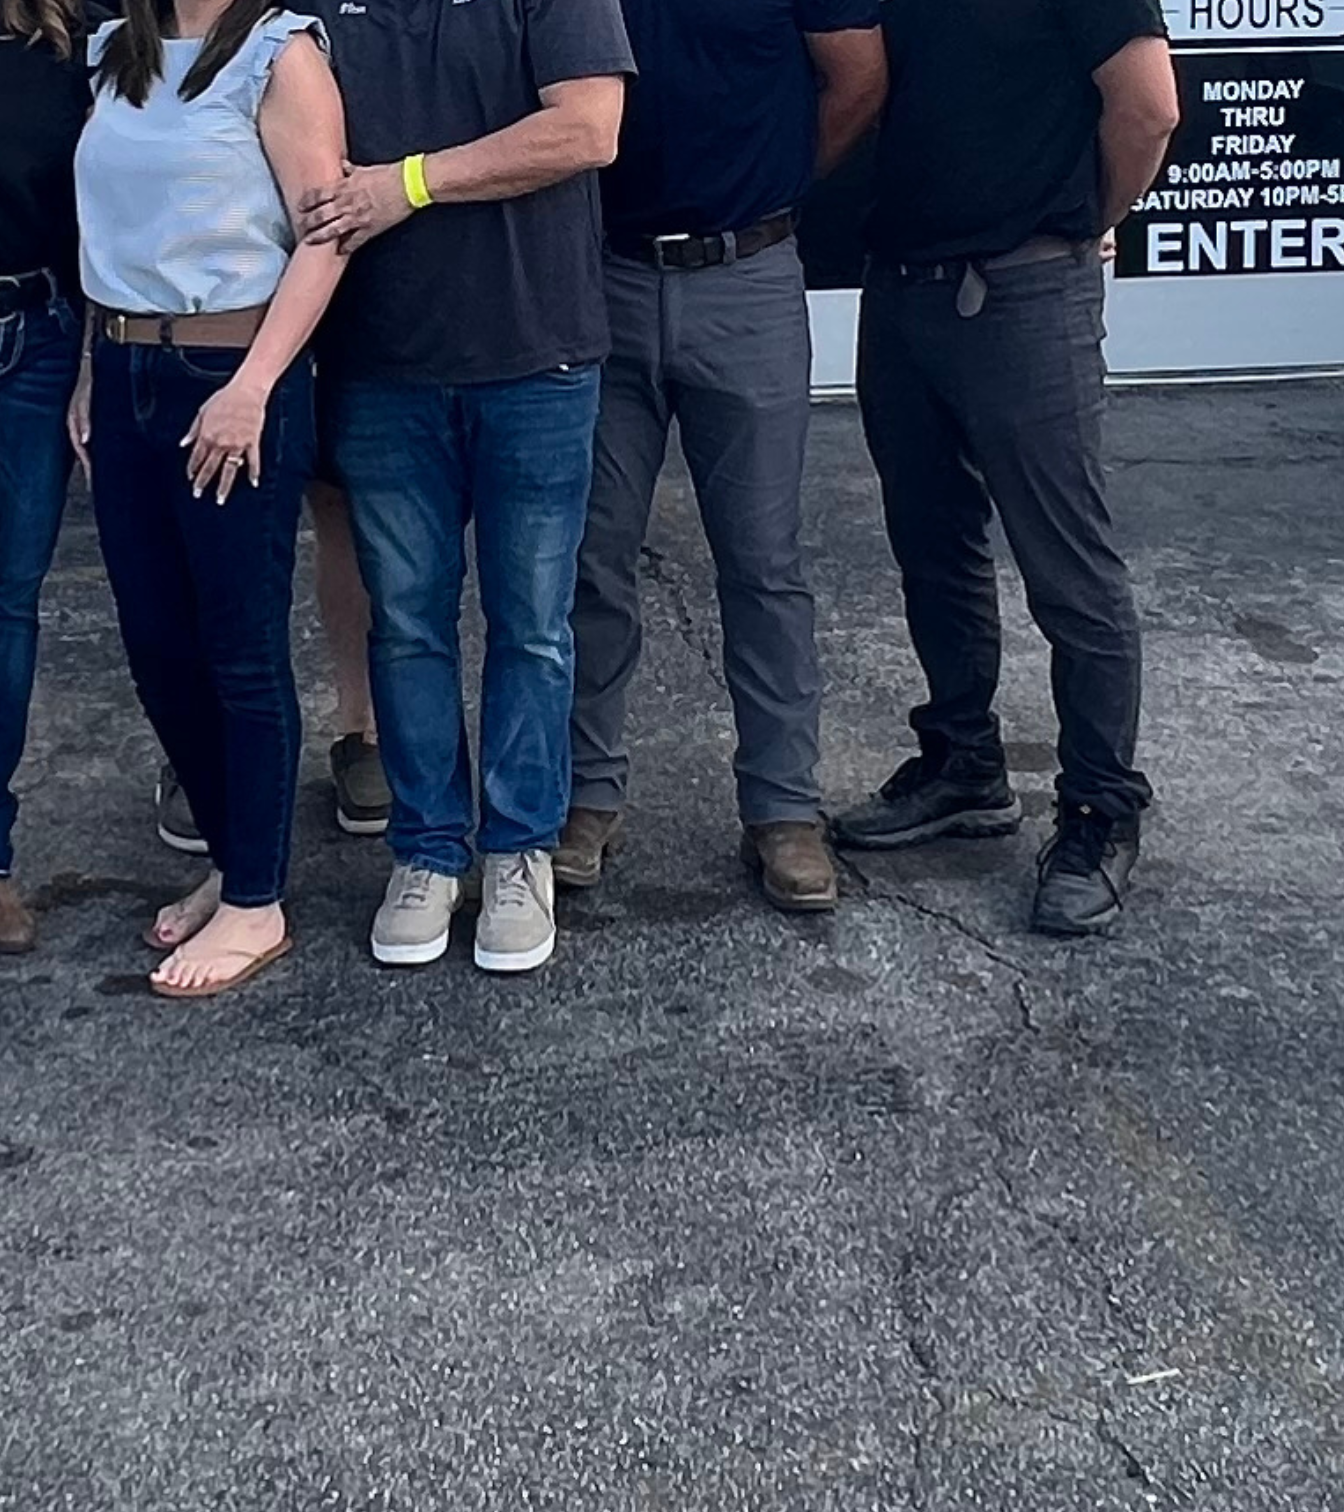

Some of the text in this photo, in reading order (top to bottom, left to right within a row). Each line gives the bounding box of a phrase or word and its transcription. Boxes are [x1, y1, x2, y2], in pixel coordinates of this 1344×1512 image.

[1203, 79, 1305, 102] MONDAY
[1220, 106, 1285, 127] THRU
[1211, 134, 1296, 155] FRIDAY
[1167, 159, 1340, 184] 9:00AM-5:00PM
